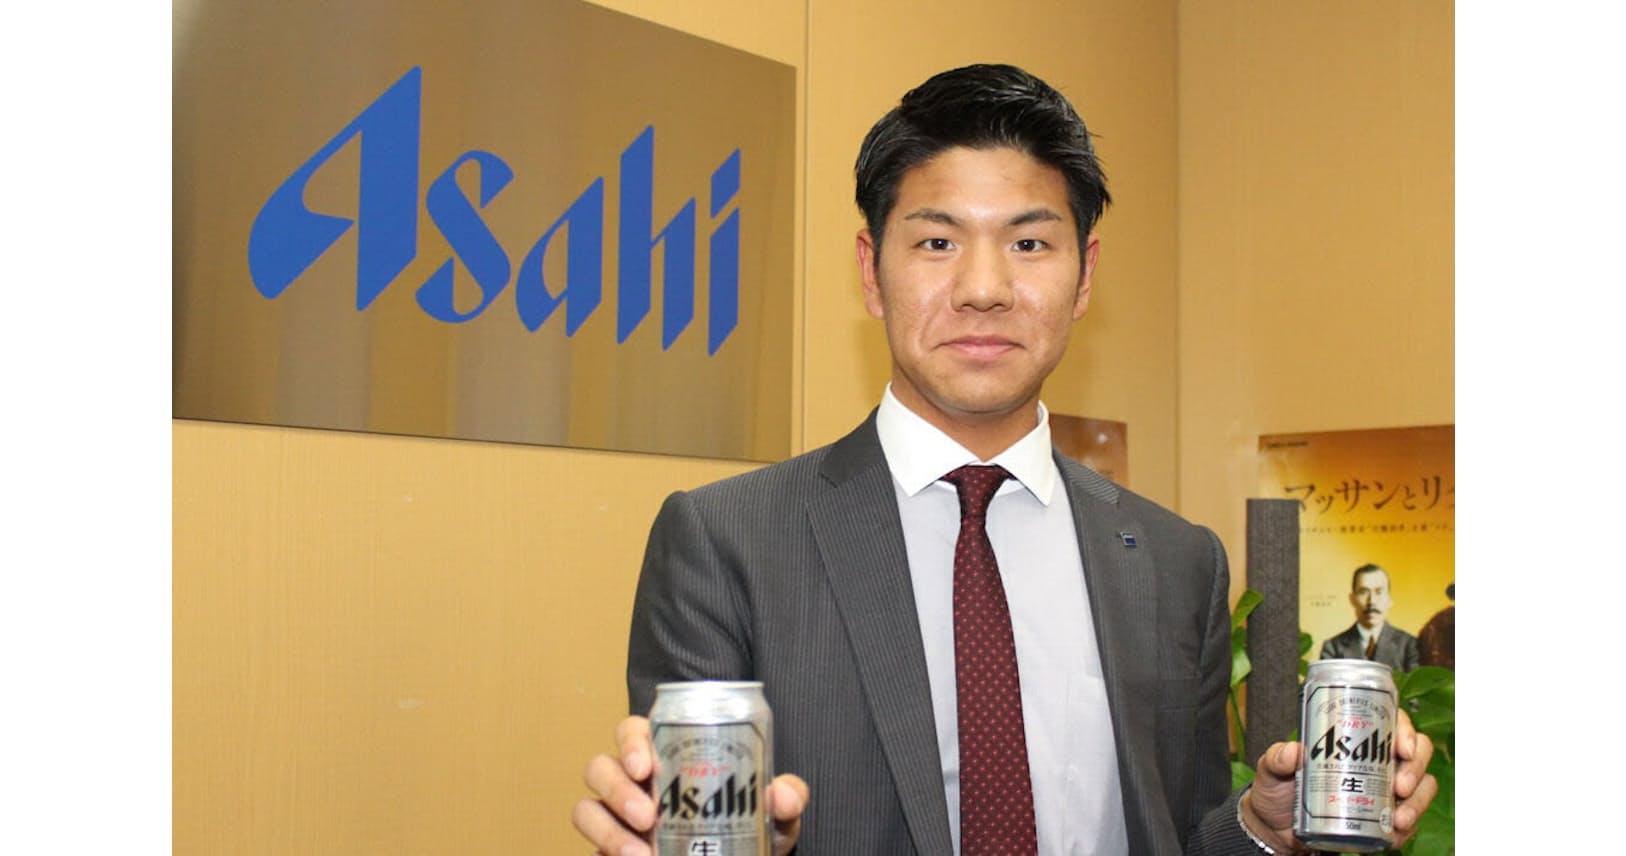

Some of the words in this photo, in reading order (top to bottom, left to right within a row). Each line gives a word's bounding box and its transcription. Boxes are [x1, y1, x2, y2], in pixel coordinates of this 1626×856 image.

[248, 65, 742, 357] Asahi
[1284, 476, 1455, 514] マッサンとリ
[1311, 725, 1392, 765] Asahi
[657, 773, 757, 820] Asahi
[1341, 777, 1364, 794] 生
